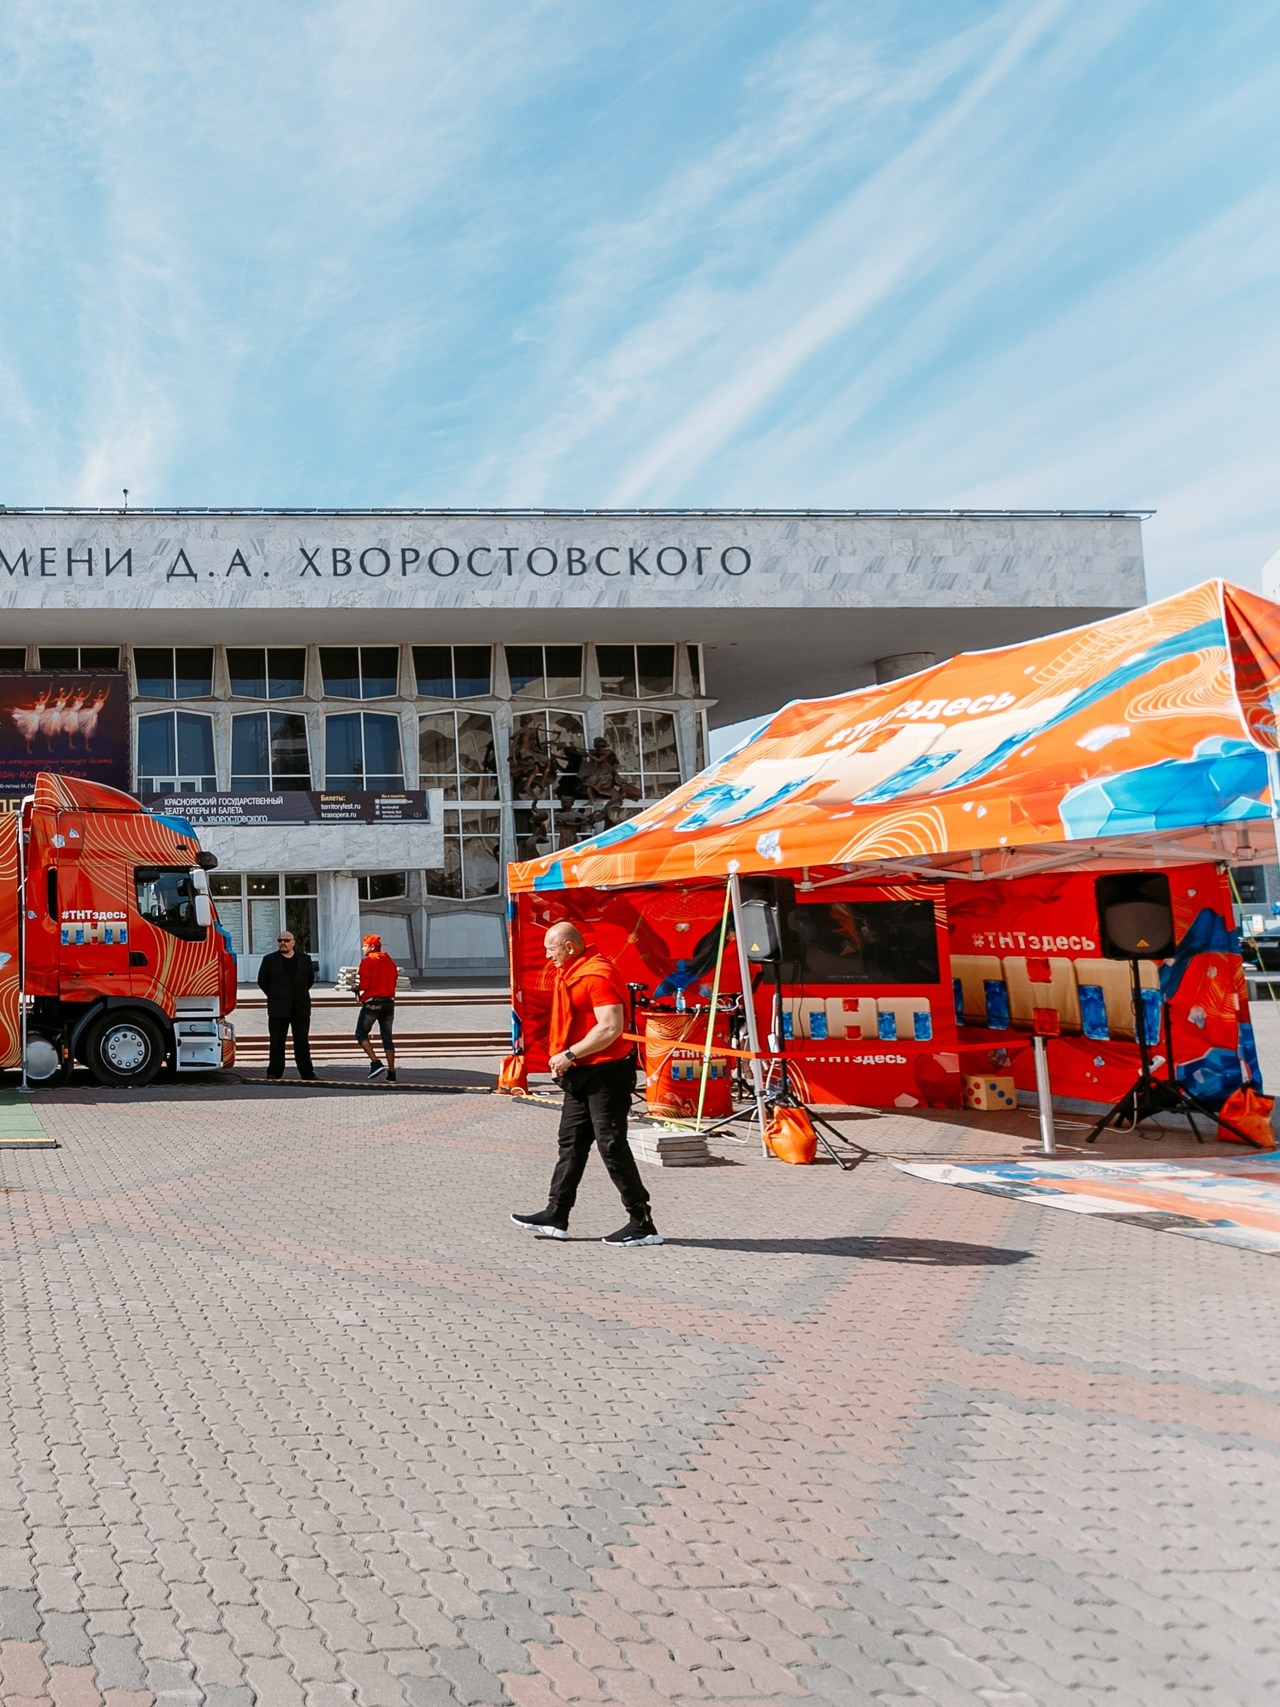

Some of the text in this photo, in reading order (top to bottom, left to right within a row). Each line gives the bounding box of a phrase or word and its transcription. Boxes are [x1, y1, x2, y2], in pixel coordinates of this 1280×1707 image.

[298, 546, 752, 578] ХВОРОСТОВСКОГО
[164, 796, 284, 806] КРАСНОЯРСКИЙ ГОСУДАРСТВЕННЫЙ
[321, 803, 361, 811] territoryfest.ru
[164, 807, 184, 815] ТЕАТР
[185, 807, 210, 815] ОПЕРЫ
[218, 806, 243, 814] БАЛЕТА
[321, 811, 357, 819] krasopera.ru
[207, 815, 268, 823] ХВОРОСТОВСКОГО
[61, 910, 127, 920] #ТНТздесь
[61, 922, 128, 945] ТНТ
[972, 931, 1096, 952] #ТНТздесь
[950, 955, 1163, 1045] ТНТ
[782, 997, 933, 1041] ТНТ
[671, 1059, 727, 1080] ТНТ
